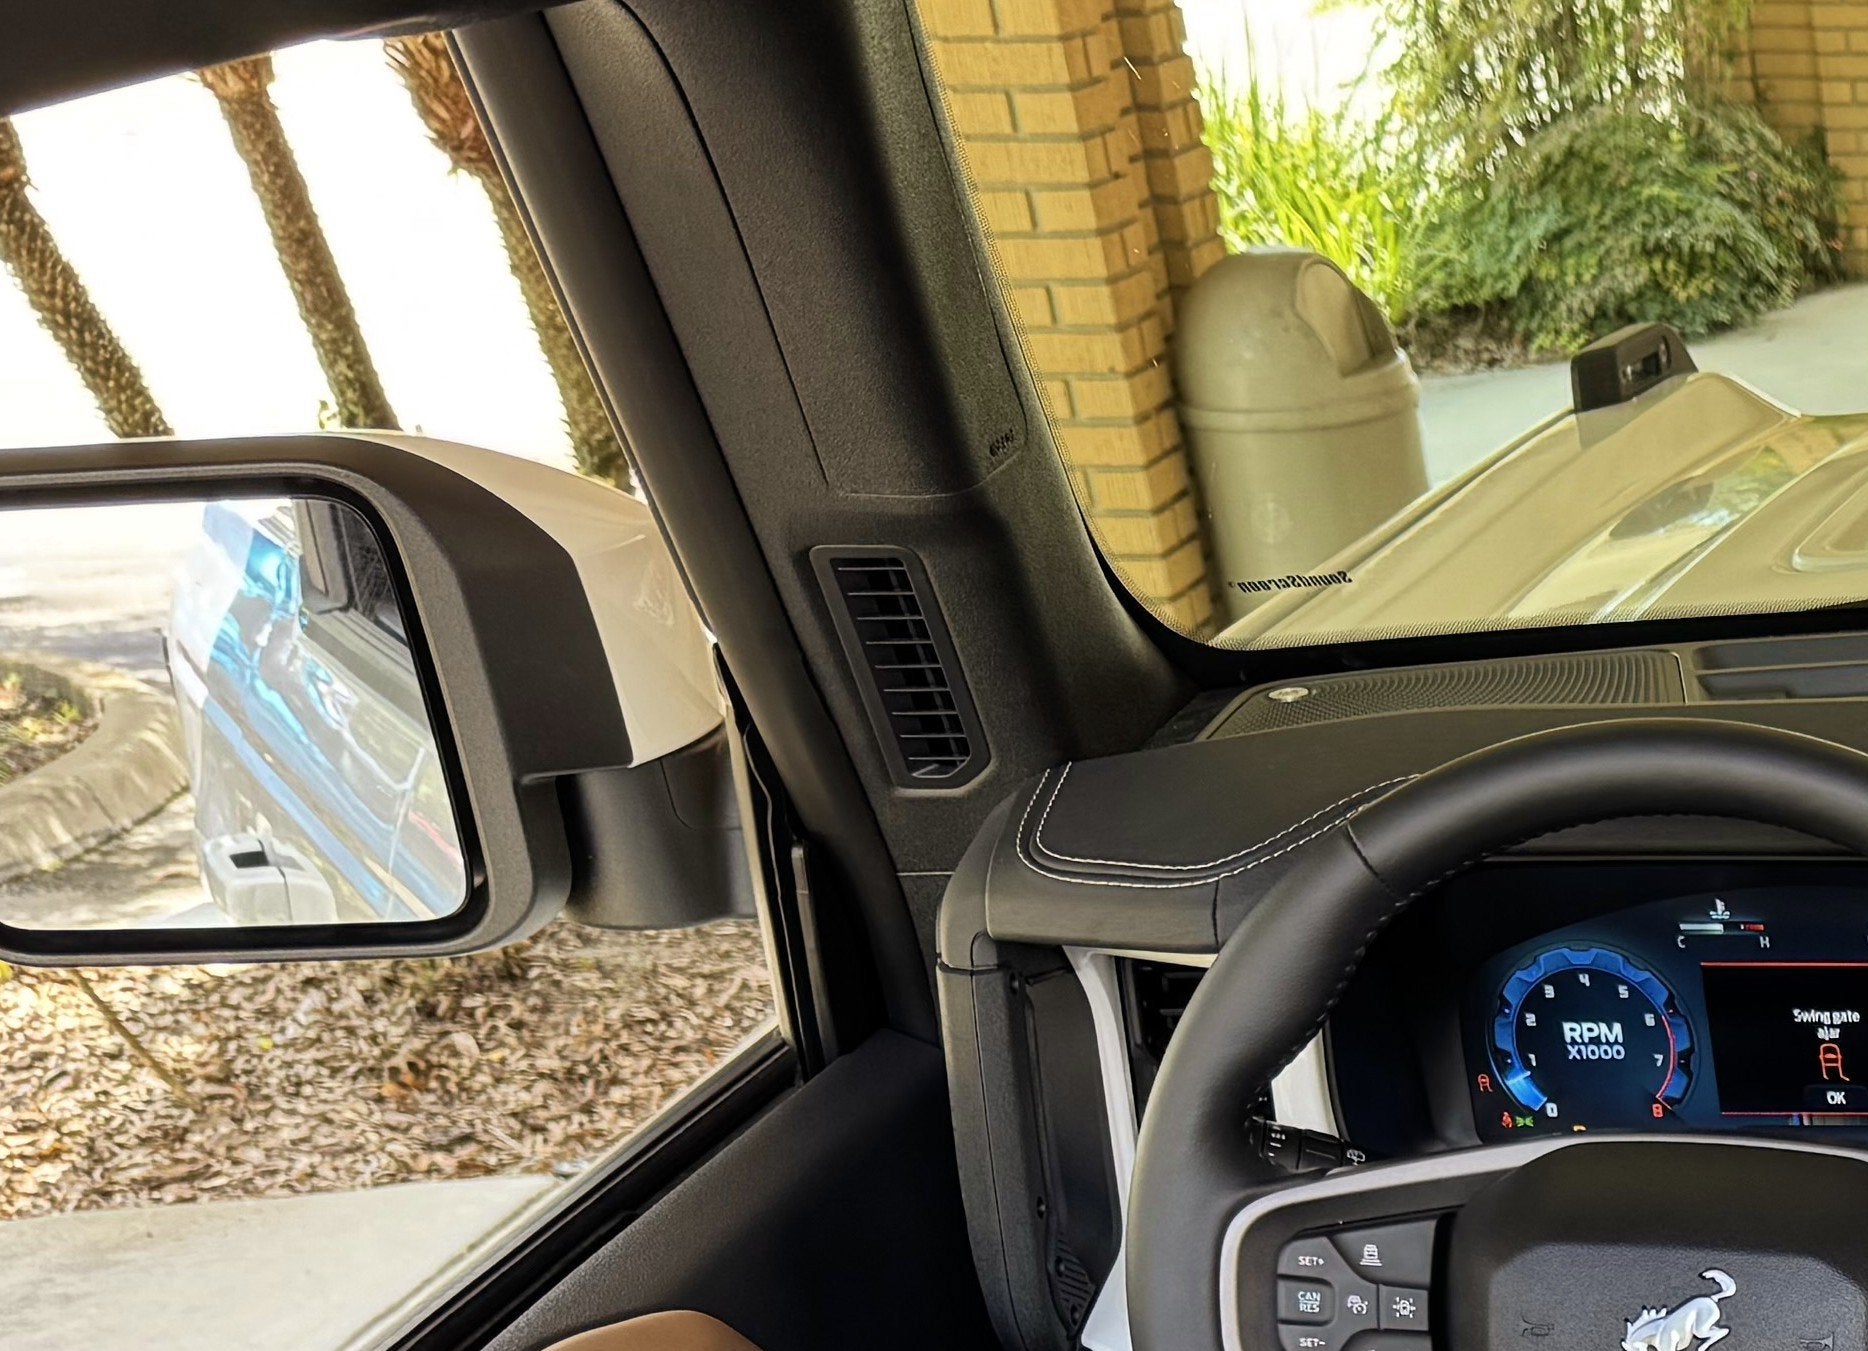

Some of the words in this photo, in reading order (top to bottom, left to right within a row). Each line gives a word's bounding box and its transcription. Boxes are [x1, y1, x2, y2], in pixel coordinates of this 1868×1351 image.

[1578, 973, 1590, 987] 4
[1543, 985, 1555, 999] 3
[1617, 985, 1629, 999] 5
[1525, 1013, 1536, 1027] 2
[1644, 1013, 1655, 1027] 6
[1793, 1007, 1830, 1026] Swing
[1831, 1009, 1861, 1026] gate
[1562, 1021, 1624, 1044] RPM
[1567, 1044, 1626, 1060] X1000
[1528, 1053, 1537, 1067] 1
[1654, 1053, 1663, 1067] 7
[1826, 1091, 1847, 1105] OK
[1545, 1103, 1558, 1118] 0
[1652, 1103, 1663, 1118] 8
